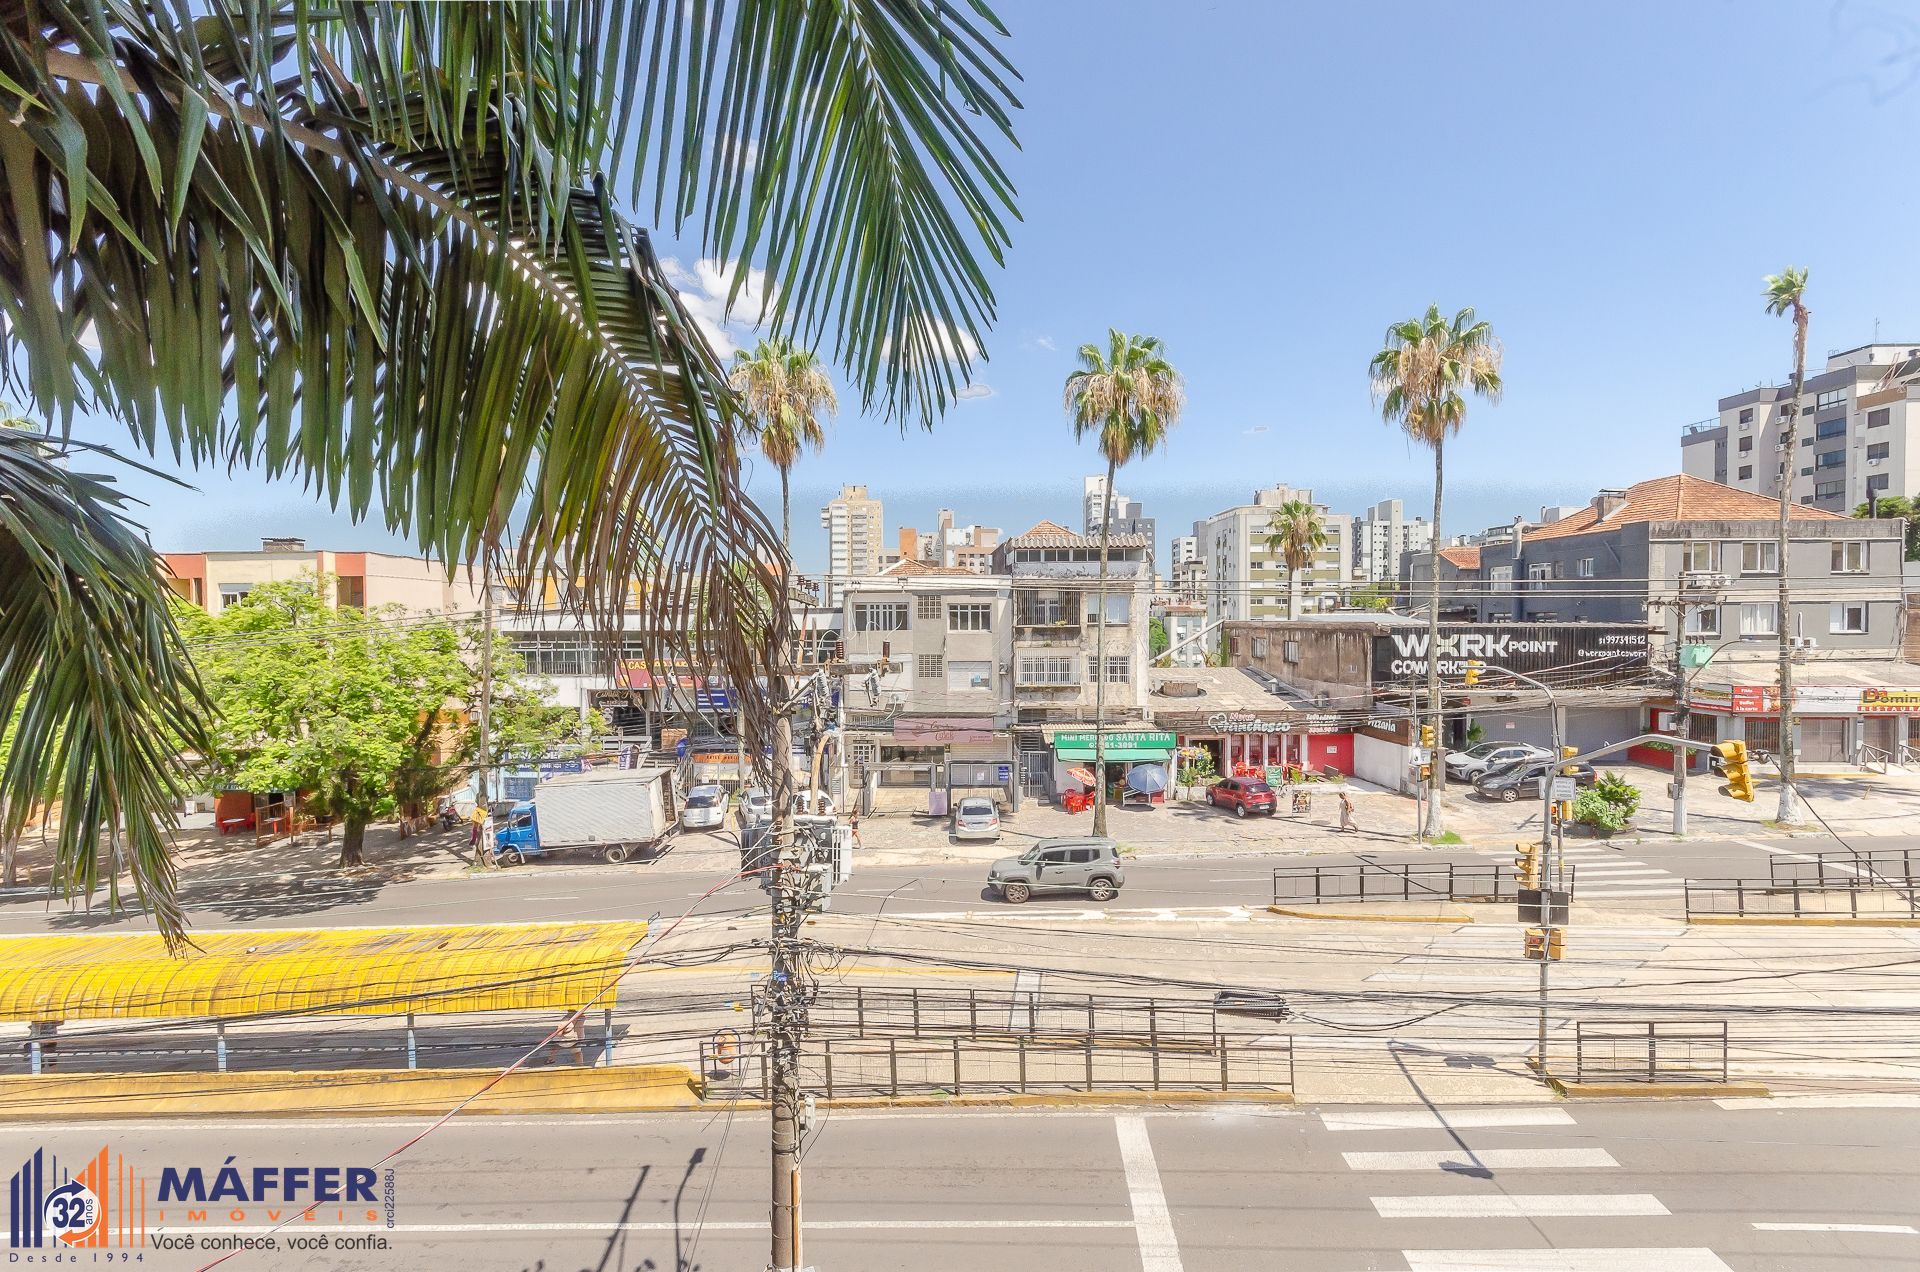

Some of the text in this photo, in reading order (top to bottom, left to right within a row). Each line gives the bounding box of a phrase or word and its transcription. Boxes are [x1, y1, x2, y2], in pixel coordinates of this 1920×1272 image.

[1508, 641, 1558, 653] POINT
[1116, 733, 1147, 741] SANTA
[1149, 733, 1171, 741] RITA
